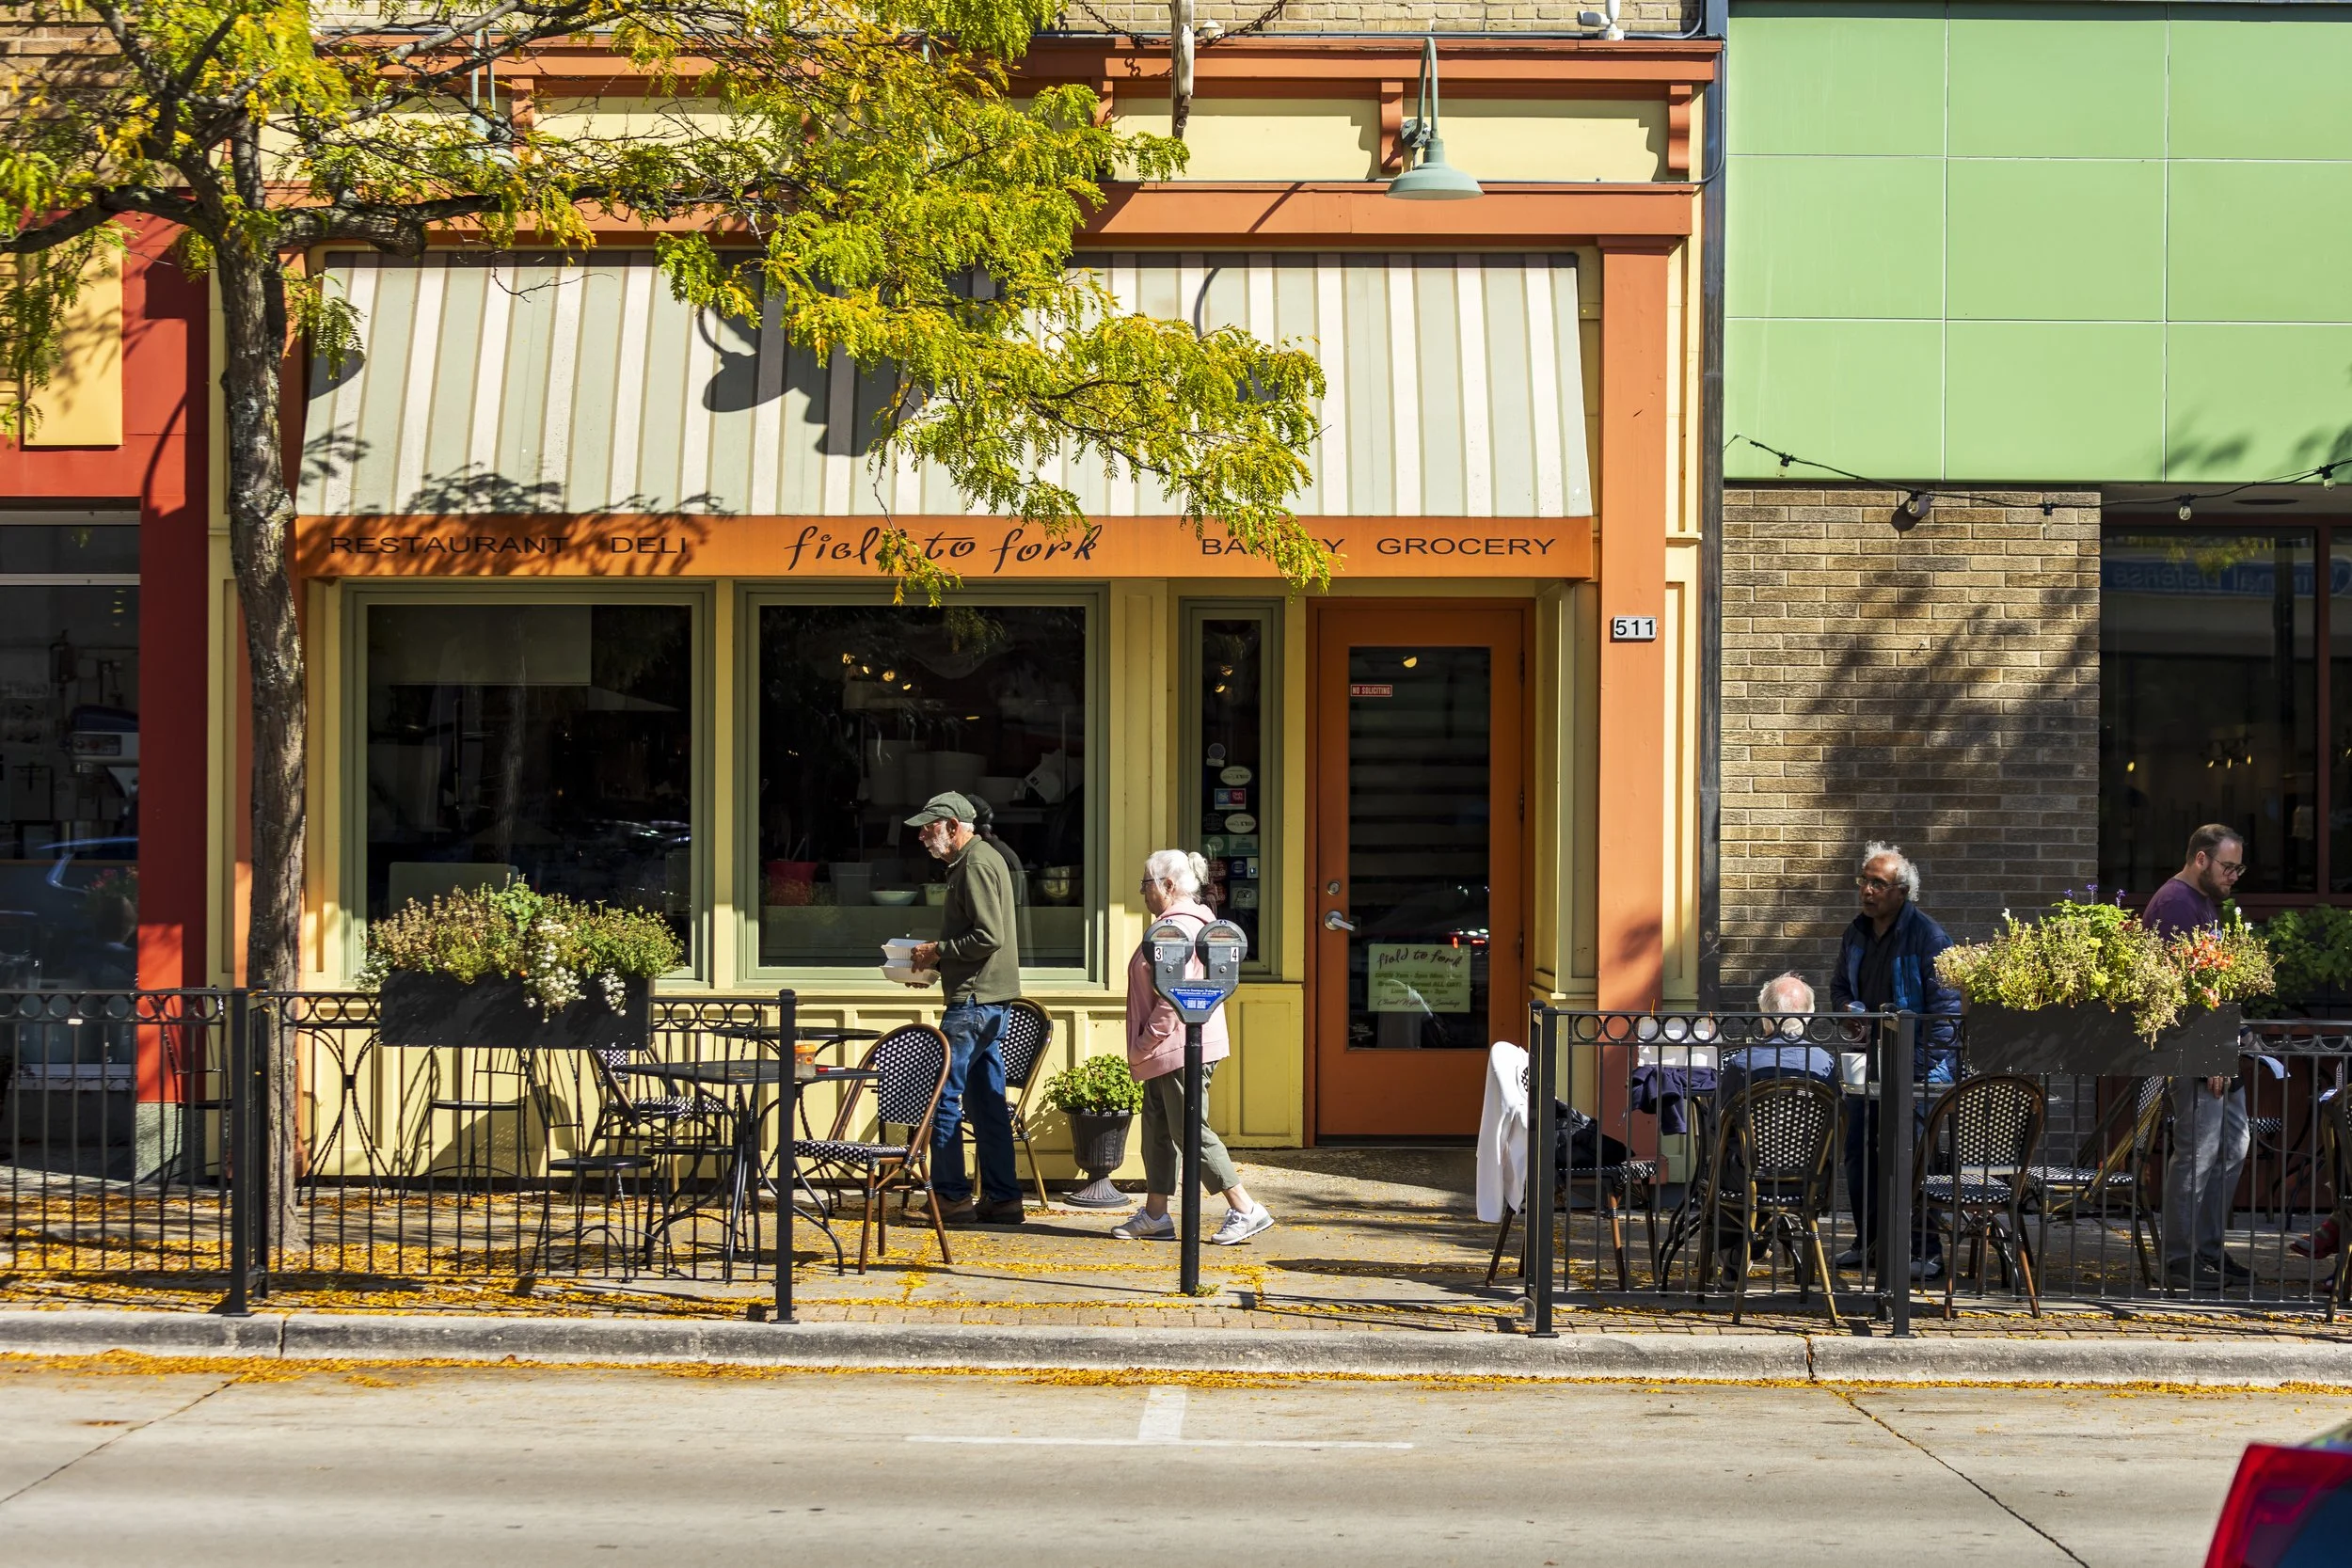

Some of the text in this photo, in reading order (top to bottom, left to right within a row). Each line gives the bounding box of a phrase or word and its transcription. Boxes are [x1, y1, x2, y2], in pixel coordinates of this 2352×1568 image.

[330, 536, 687, 553] RESTAURANT DELI
[784, 524, 1104, 574] fiel to fork
[1202, 538, 1557, 555] BAKY GROCERY
[1614, 619, 1654, 636] 511
[1155, 948, 1162, 959] 3
[1232, 948, 1237, 960] 4
[1377, 947, 1463, 969] field to fork
